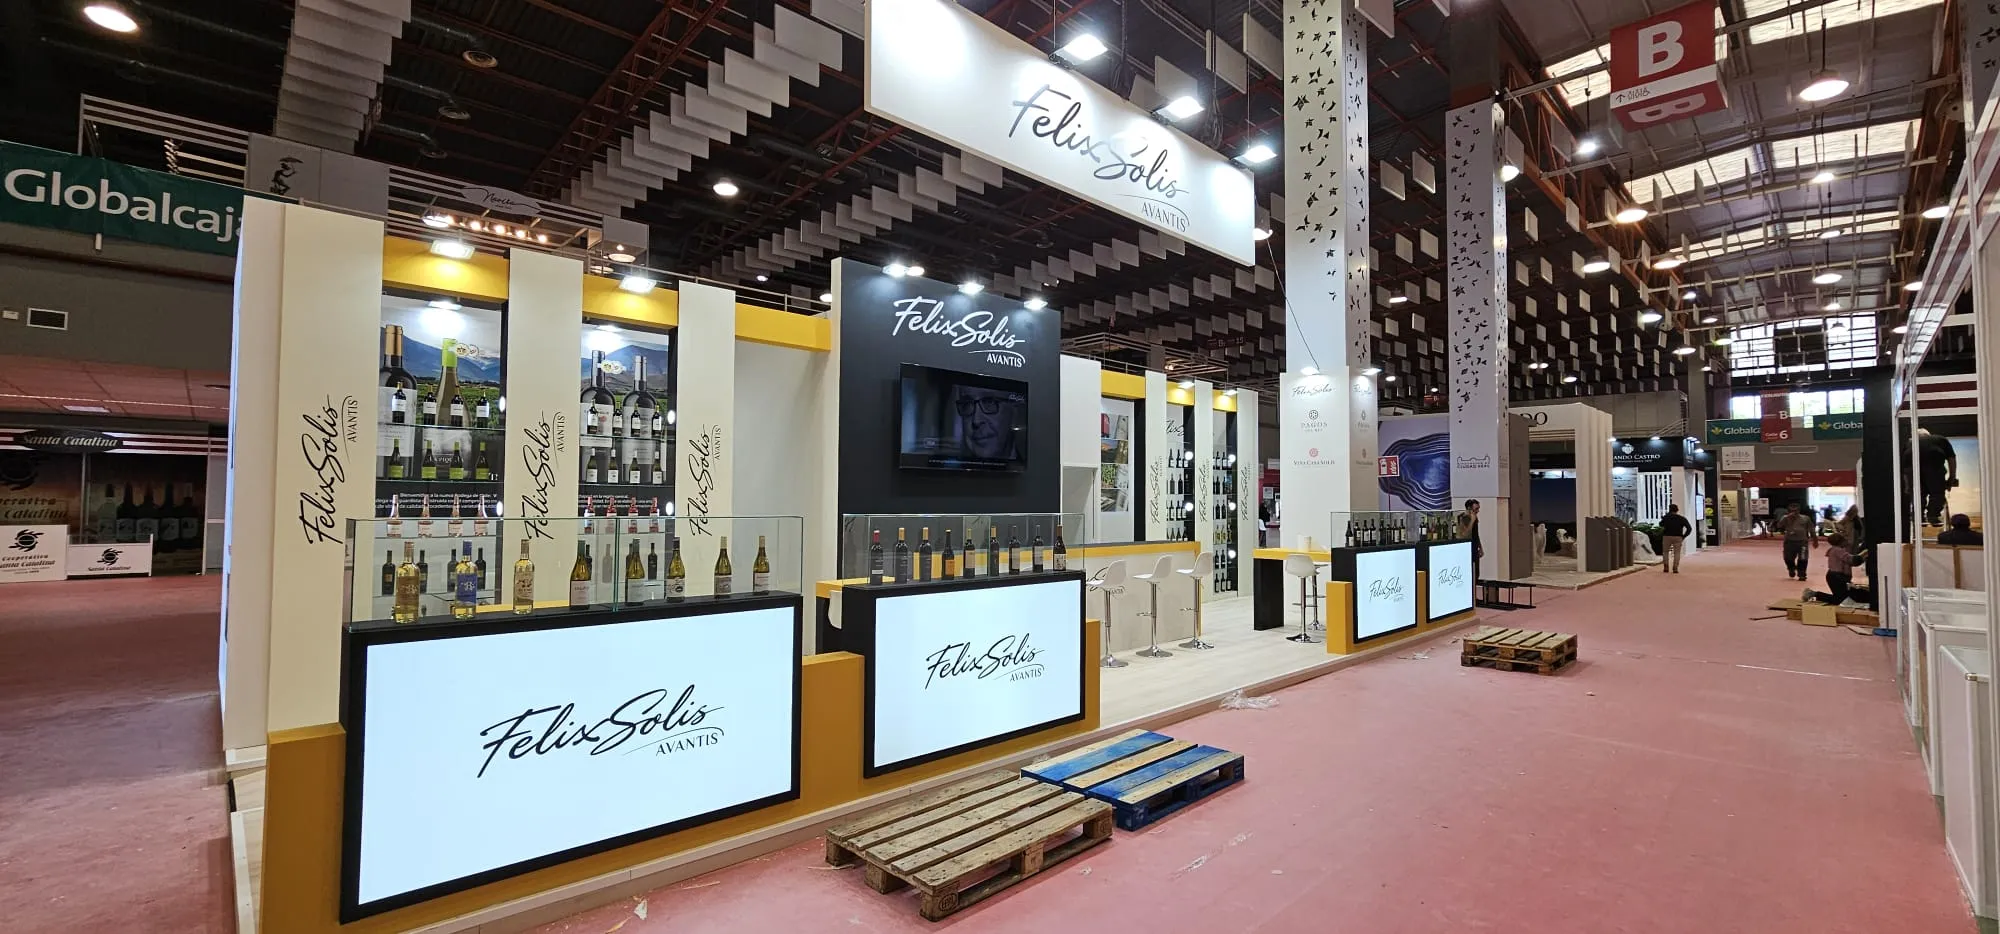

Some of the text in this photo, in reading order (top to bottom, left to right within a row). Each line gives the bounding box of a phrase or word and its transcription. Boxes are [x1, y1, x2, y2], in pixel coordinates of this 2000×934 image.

[1638, 20, 1684, 78] B
[1141, 201, 1187, 233] AVANTIS
[892, 296, 1026, 348] Felix Solis
[986, 353, 1022, 368] AVANTIS
[348, 400, 358, 442] AVANTIS
[1779, 411, 1788, 420] B
[1833, 421, 1863, 430] Globa
[24, 436, 118, 447] Santa Catalina
[557, 415, 565, 452] AVANTIS
[1724, 427, 1760, 435] Globalca
[1779, 430, 1788, 439] 6
[925, 632, 1045, 690] Felix Solis
[1010, 668, 1041, 682] AVANTIS
[477, 684, 725, 778] Felix Solis
[656, 732, 719, 757] AVANTIS
